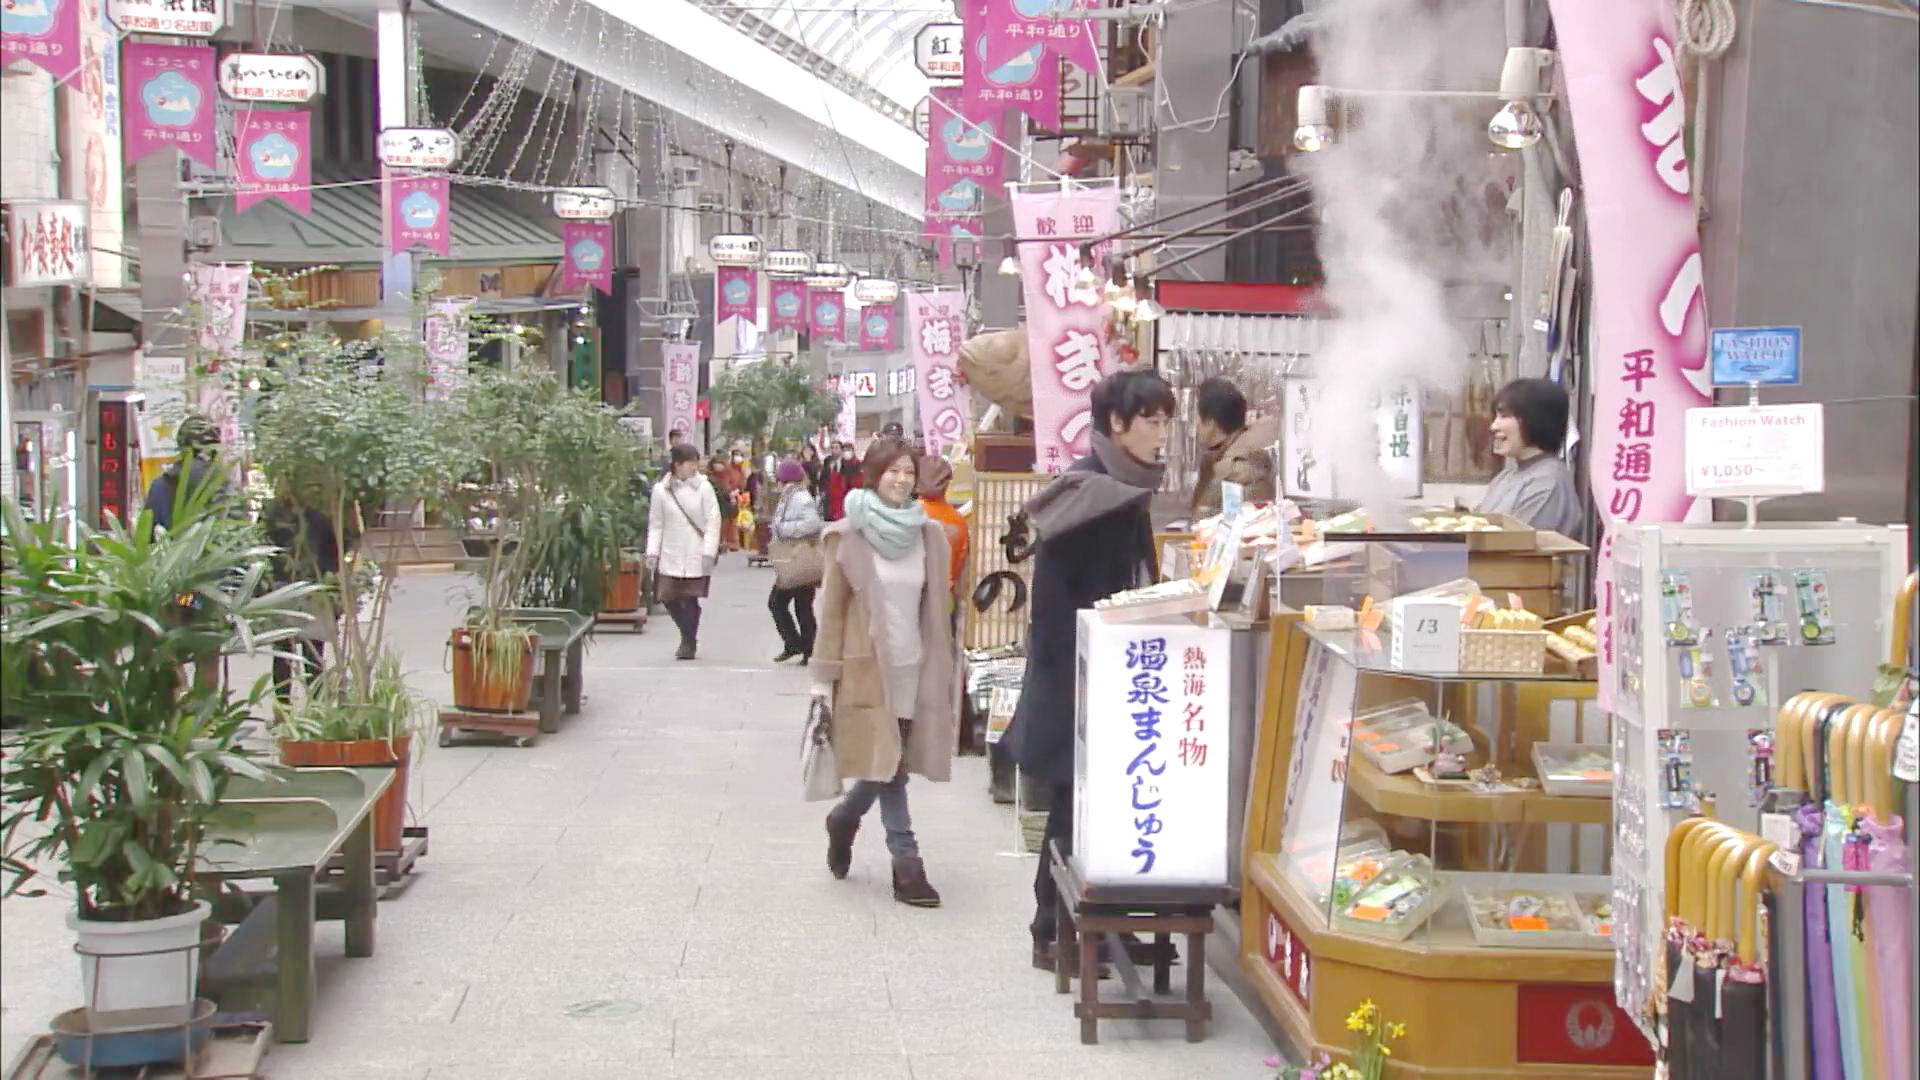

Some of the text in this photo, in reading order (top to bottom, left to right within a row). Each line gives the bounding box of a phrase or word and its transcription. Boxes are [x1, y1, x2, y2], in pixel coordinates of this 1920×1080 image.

[1004, 23, 1081, 38] 平和通り
[142, 57, 201, 69] ようこそ
[978, 88, 1043, 101] 平和通り
[143, 129, 202, 142] 平和通り
[942, 164, 995, 176] 平和通り
[1720, 336, 1792, 350] FASHION
[1727, 350, 1785, 361] WATCH
[1701, 414, 1806, 428] Fashion Watch
[1178, 646, 1208, 767] 熱海名物
[1125, 637, 1170, 874] 温泉まんじゅう
